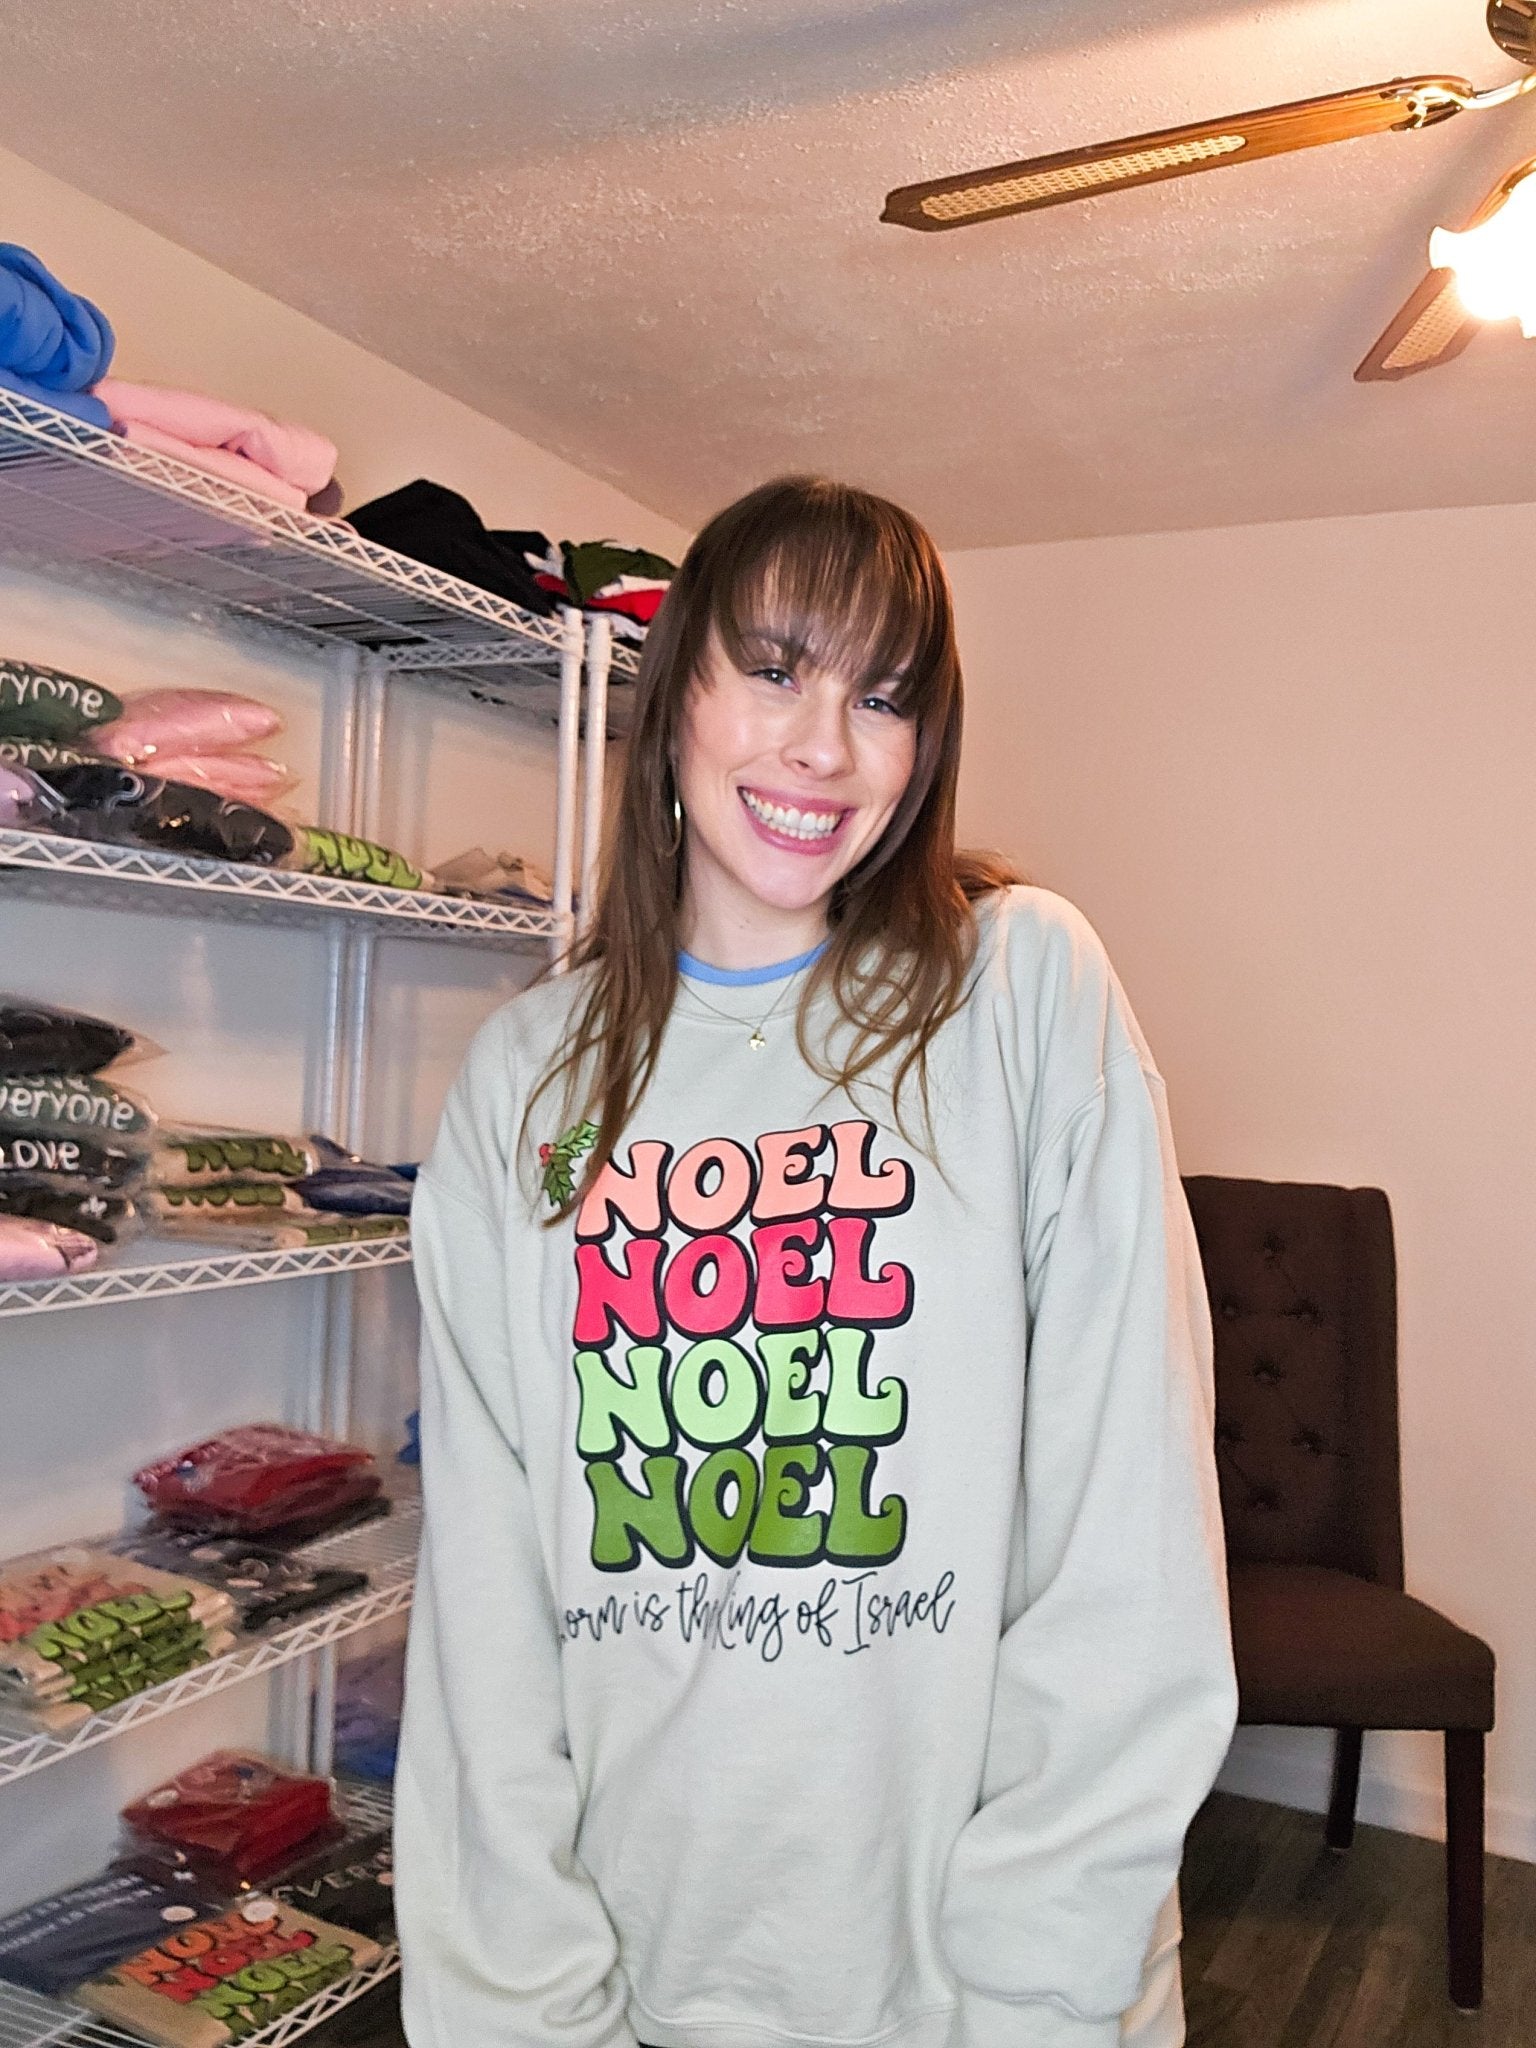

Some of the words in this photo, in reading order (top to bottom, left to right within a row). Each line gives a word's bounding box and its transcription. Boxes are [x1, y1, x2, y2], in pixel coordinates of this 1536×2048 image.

[574, 1119, 916, 1244] NOEL
[573, 1215, 914, 1350] NOEL
[574, 1326, 909, 1461] NOEL
[584, 1442, 908, 1573] NOEL
[561, 1594, 628, 1642] orn
[633, 1591, 671, 1632] is
[797, 1577, 839, 1648] of
[841, 1570, 957, 1655] Israel
